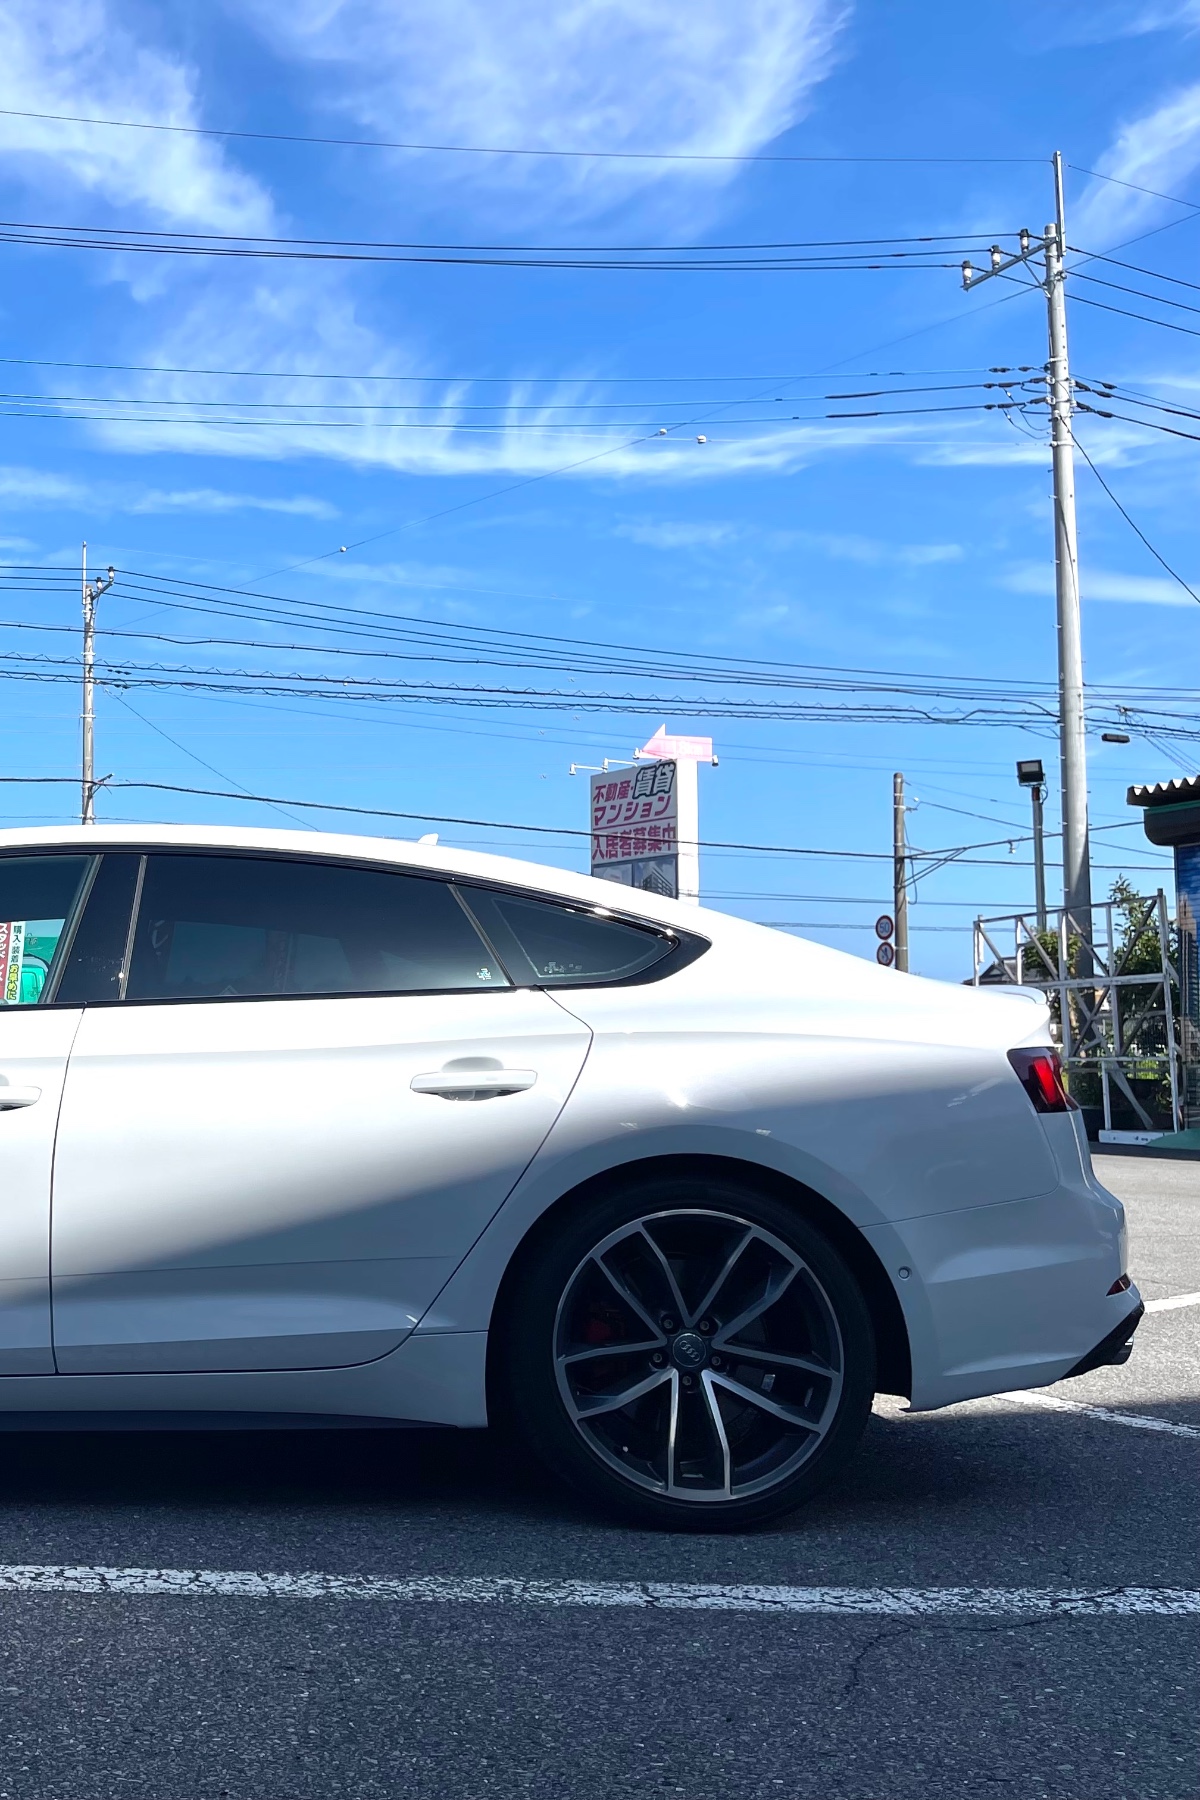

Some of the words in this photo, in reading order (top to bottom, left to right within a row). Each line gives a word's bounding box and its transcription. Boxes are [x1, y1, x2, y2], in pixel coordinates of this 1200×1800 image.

[594, 795, 671, 825] マンション
[592, 823, 676, 860] 入居者募集中
[880, 921, 890, 934] 50
